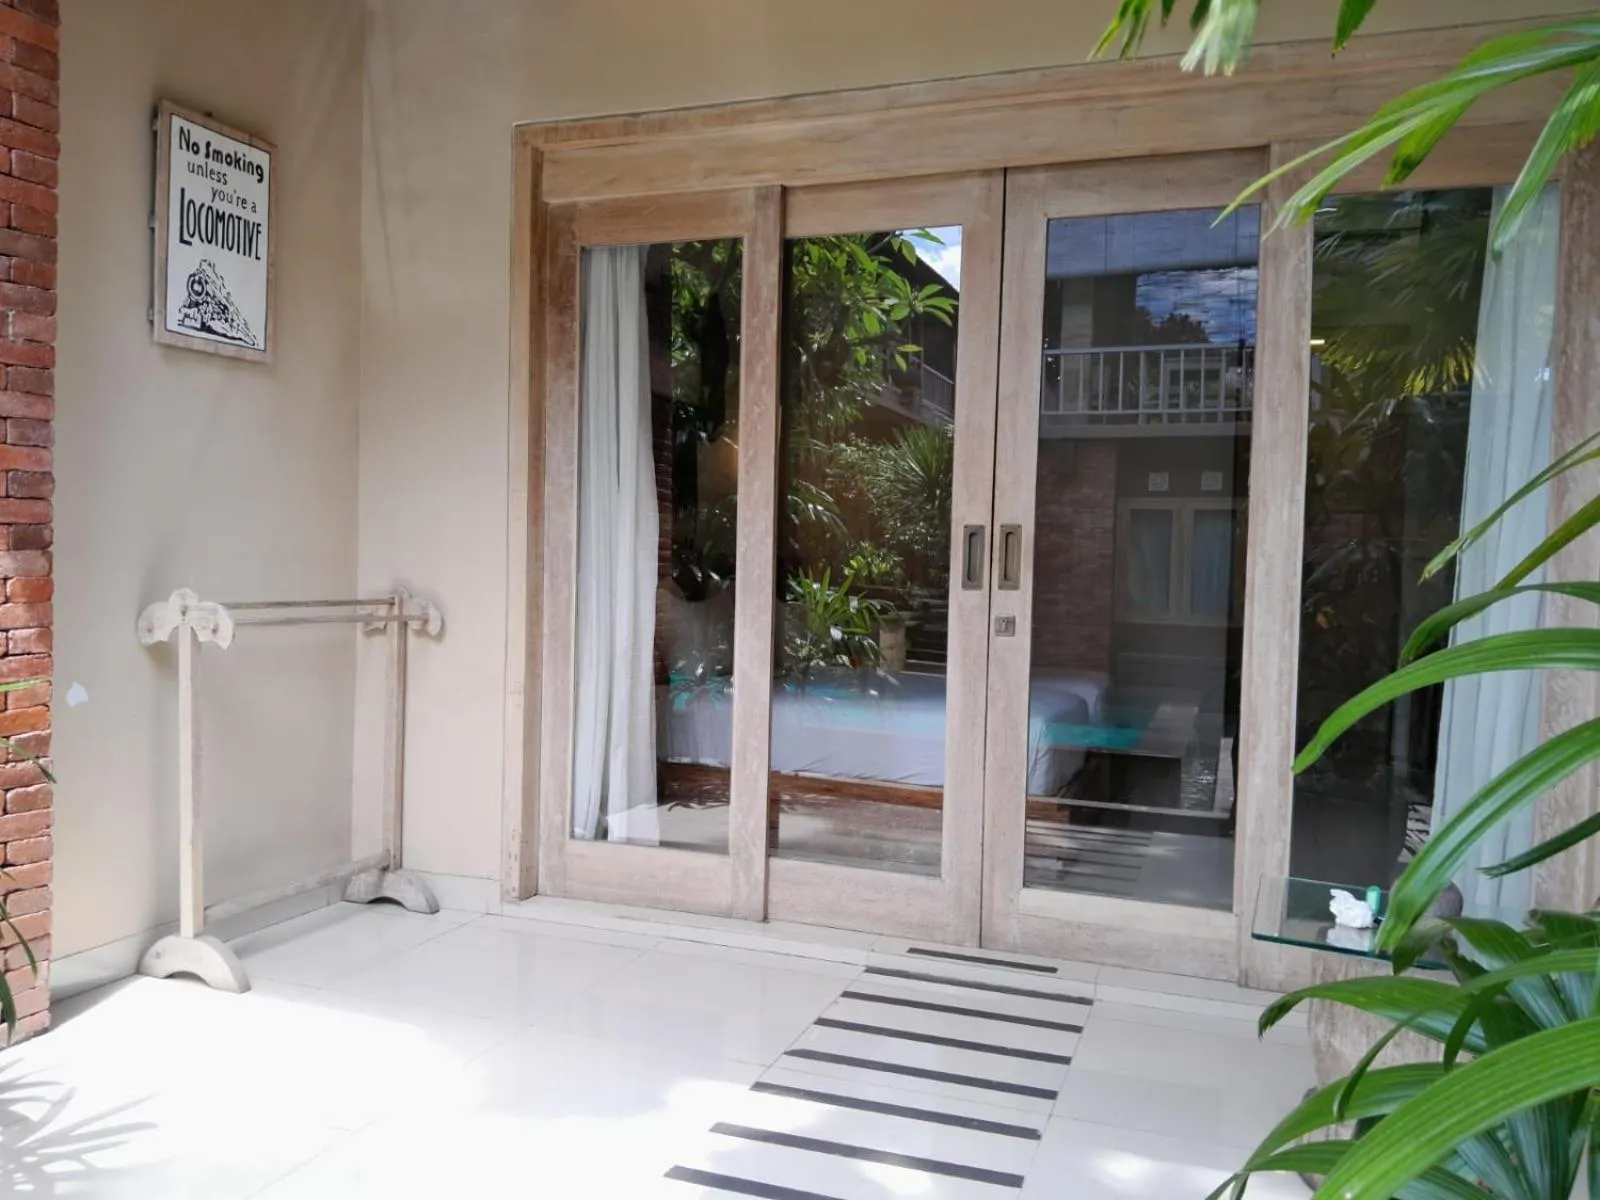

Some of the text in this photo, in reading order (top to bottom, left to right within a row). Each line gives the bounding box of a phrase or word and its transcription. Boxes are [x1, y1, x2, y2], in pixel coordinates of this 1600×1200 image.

[179, 126, 264, 184] No Smoking
[187, 160, 227, 186] unless
[211, 186, 257, 213] you're a
[179, 187, 262, 261] LOCOMOTIVE
